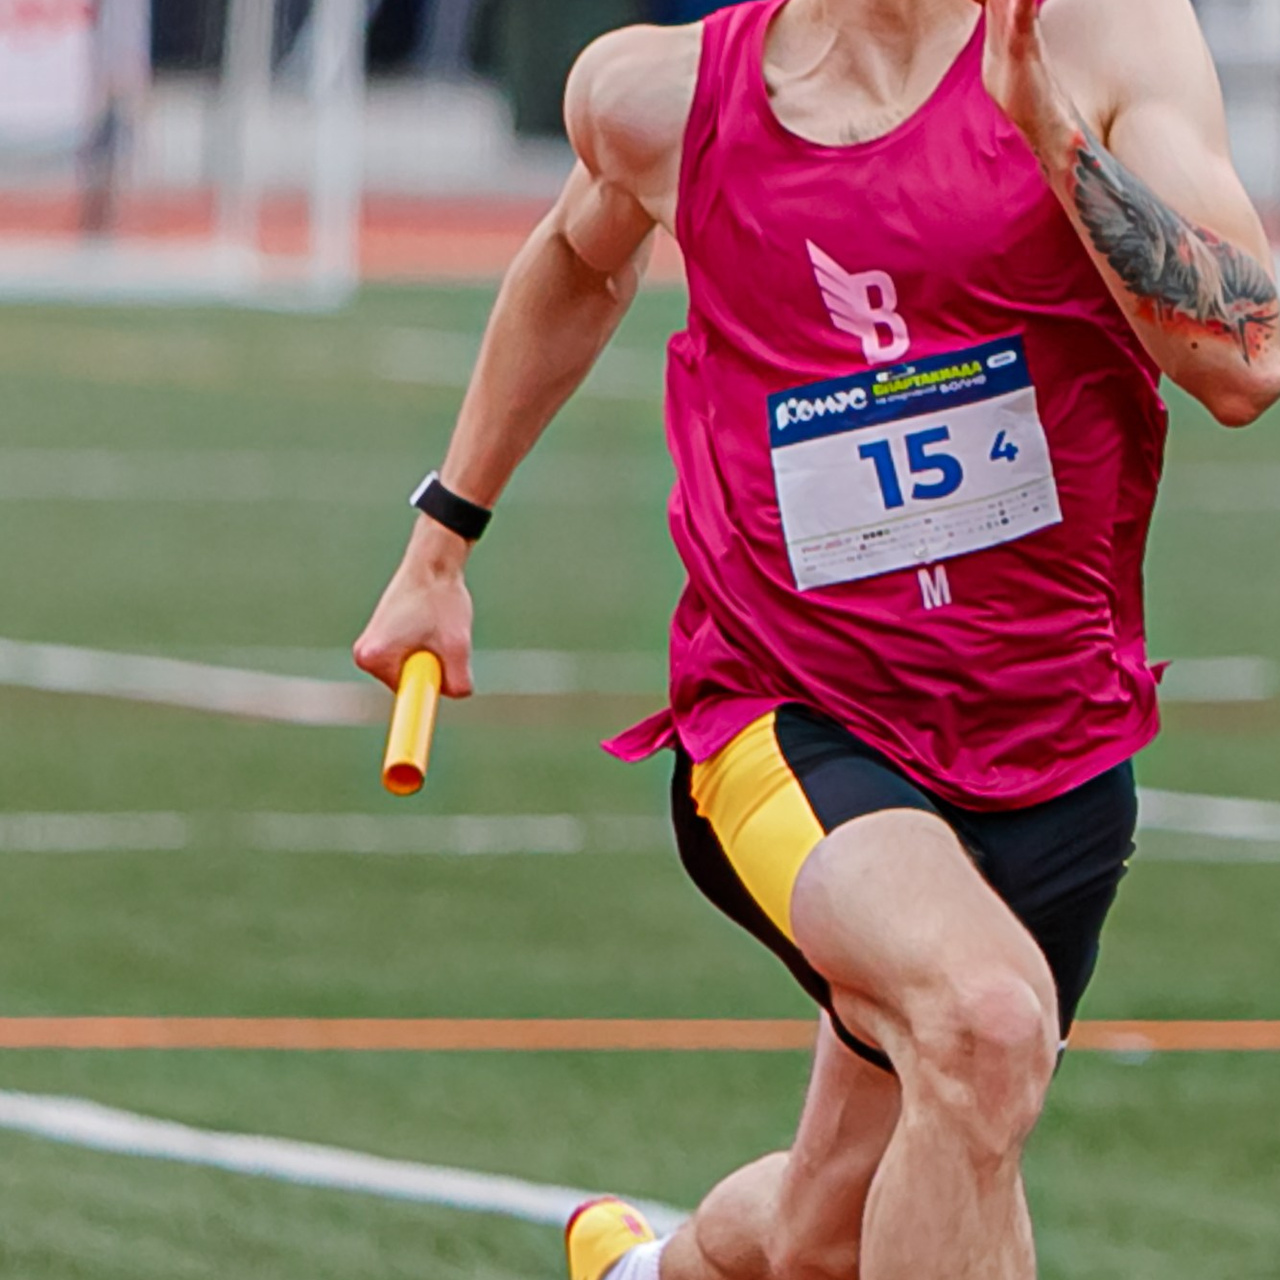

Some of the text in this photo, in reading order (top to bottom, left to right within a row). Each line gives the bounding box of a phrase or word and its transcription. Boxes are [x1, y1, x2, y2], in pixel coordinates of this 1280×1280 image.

[857, 424, 1019, 510] 15 4
[917, 564, 952, 611] M
